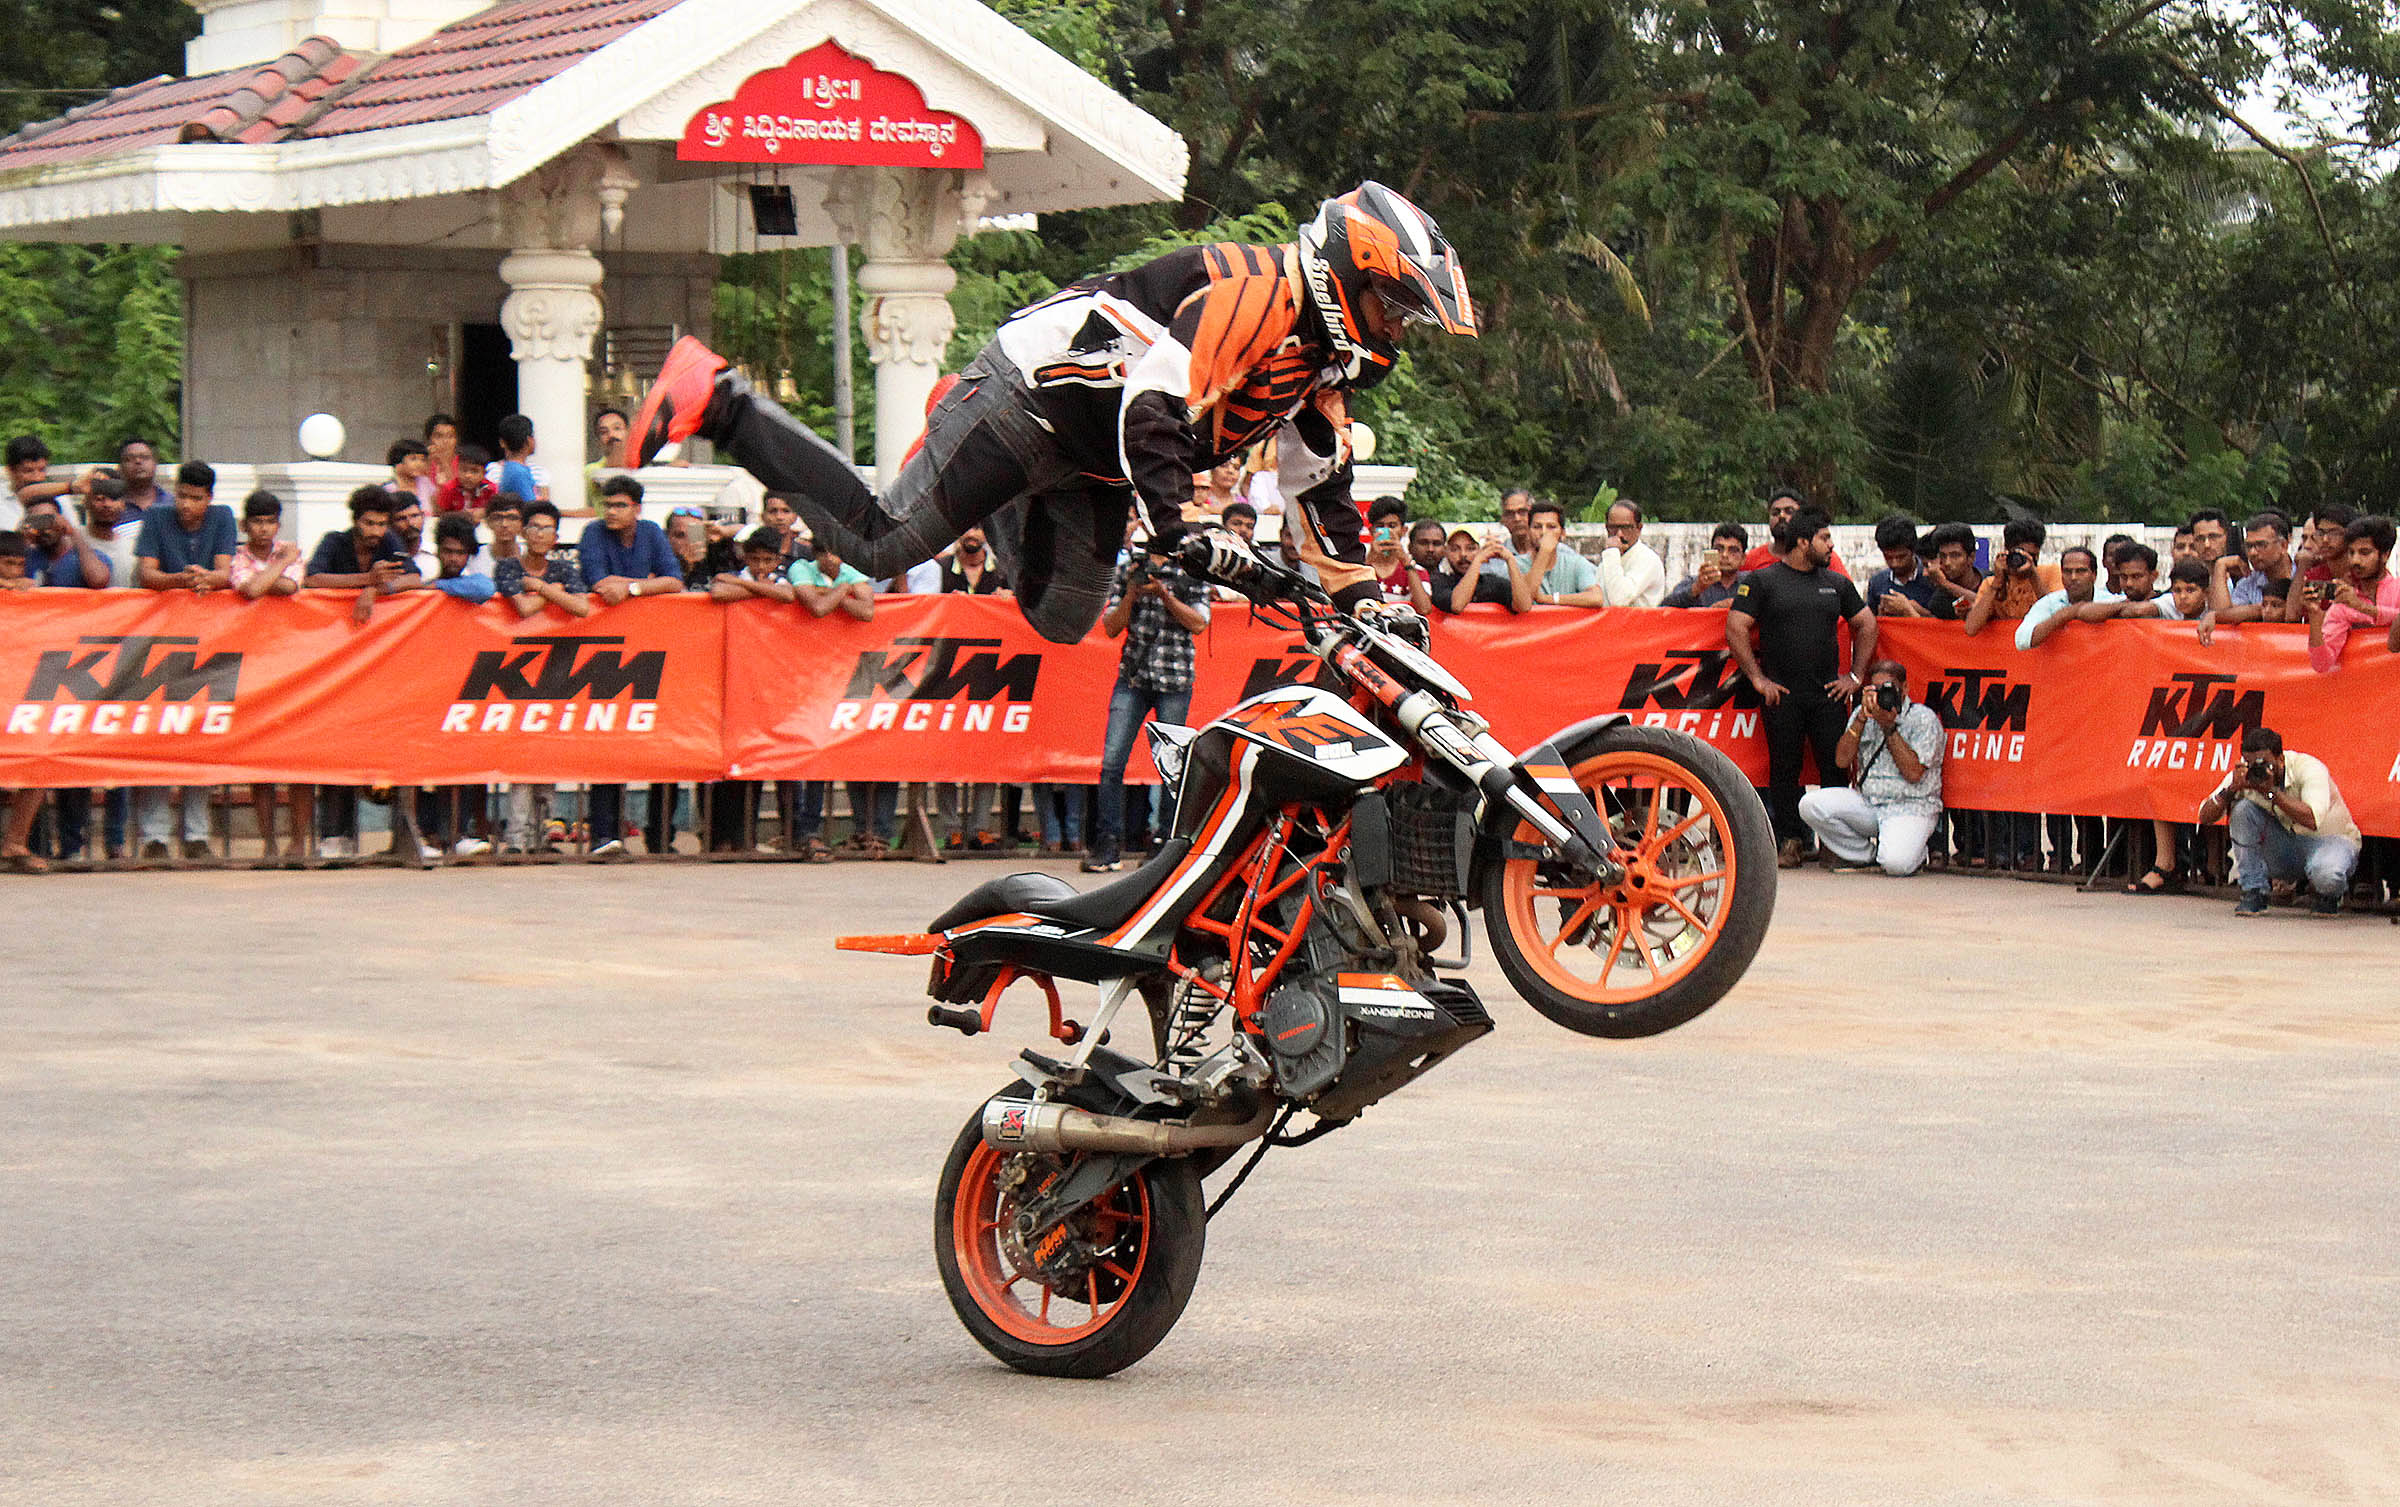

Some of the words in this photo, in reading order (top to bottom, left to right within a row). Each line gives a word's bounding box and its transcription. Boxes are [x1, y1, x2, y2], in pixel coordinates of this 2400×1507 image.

[1311, 257, 1354, 352] Steelbird
[22, 635, 243, 701] KTM
[457, 635, 667, 700] KTM
[843, 637, 1042, 702] KTM
[1924, 668, 2032, 732] KTM
[2138, 672, 2265, 740] KTM
[2126, 738, 2233, 772] RACiN
